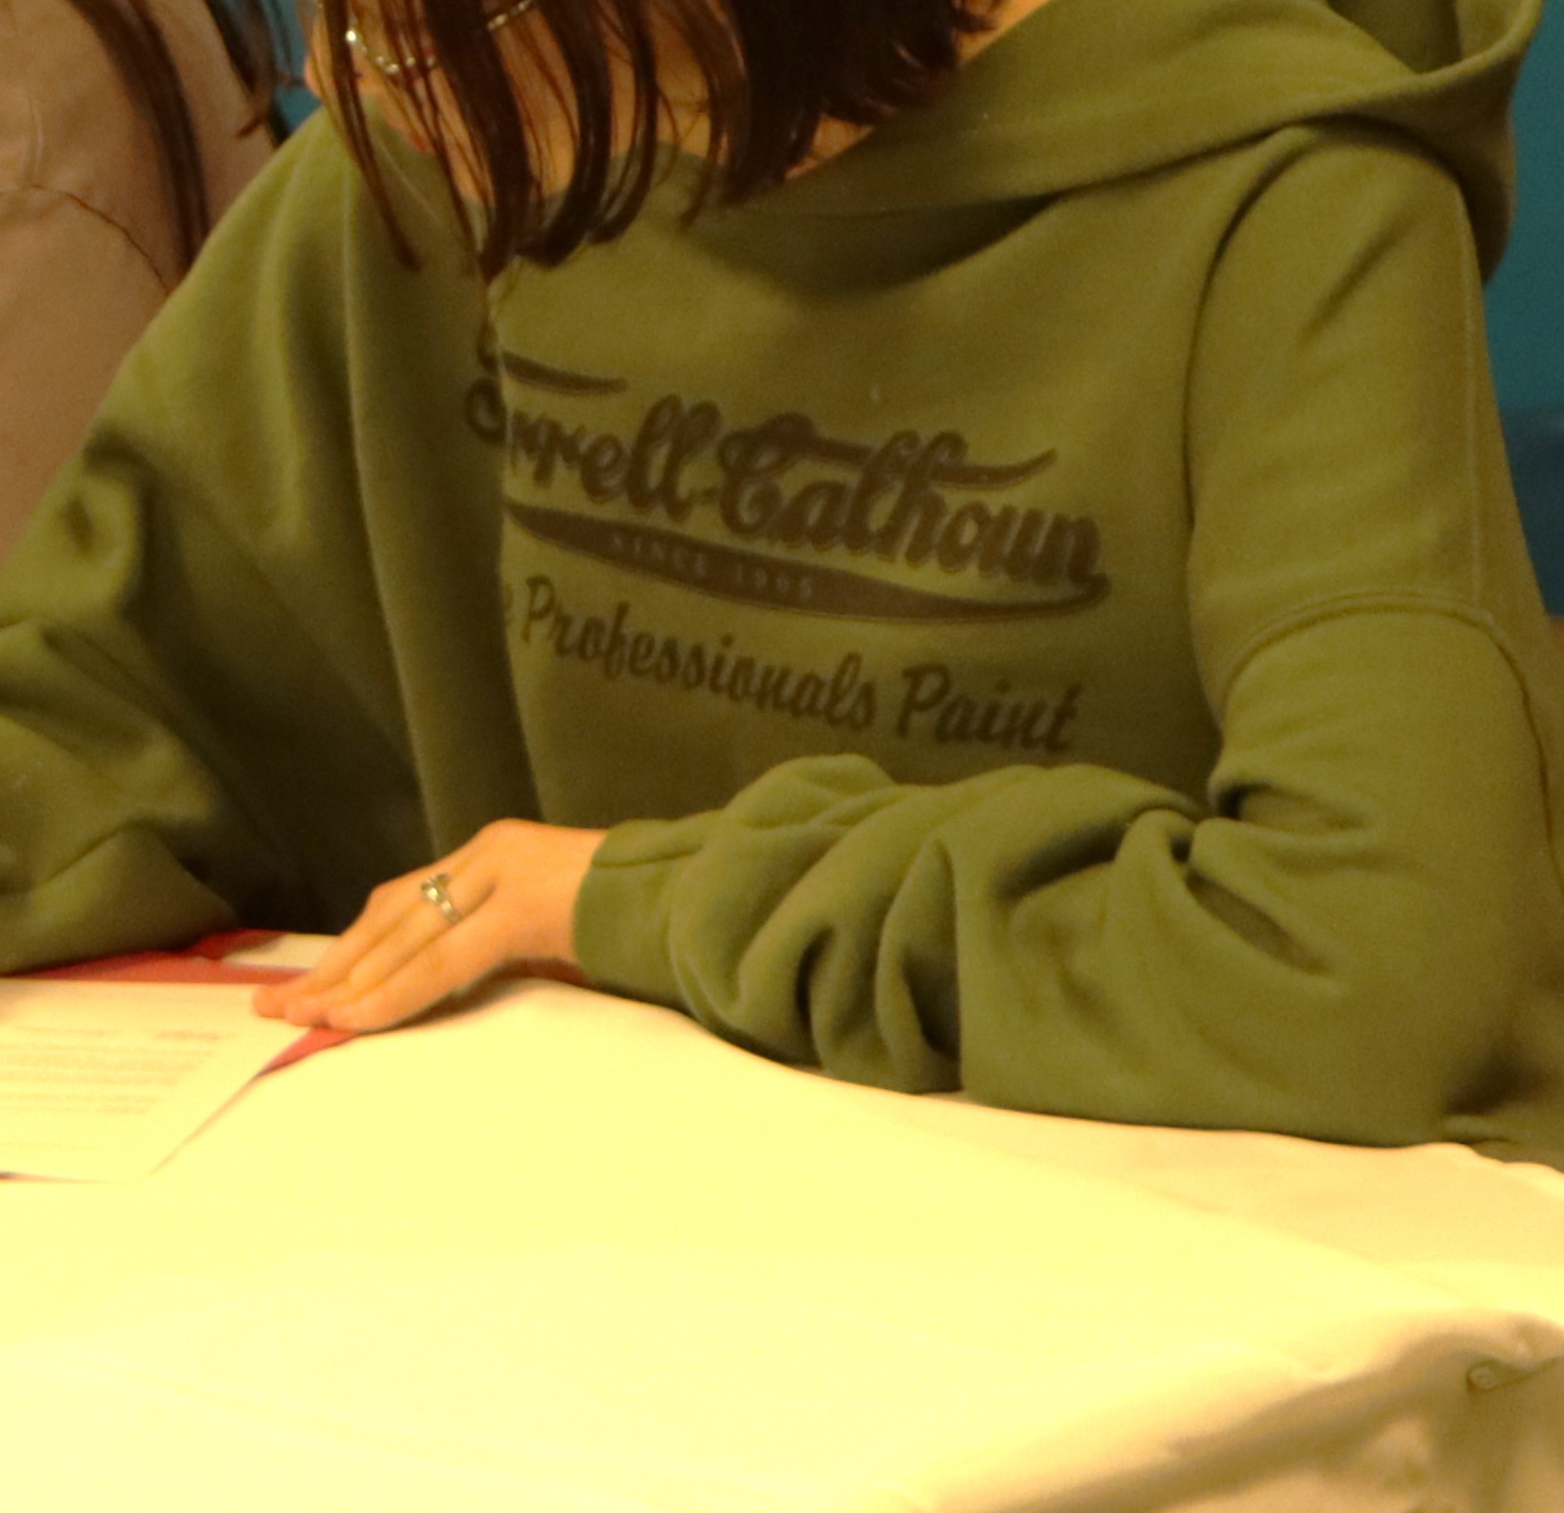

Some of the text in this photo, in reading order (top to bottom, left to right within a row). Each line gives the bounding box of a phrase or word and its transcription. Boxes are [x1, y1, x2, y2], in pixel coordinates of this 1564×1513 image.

[612, 532, 709, 580] SINCE
[521, 574, 1081, 754] Professionals Paint
